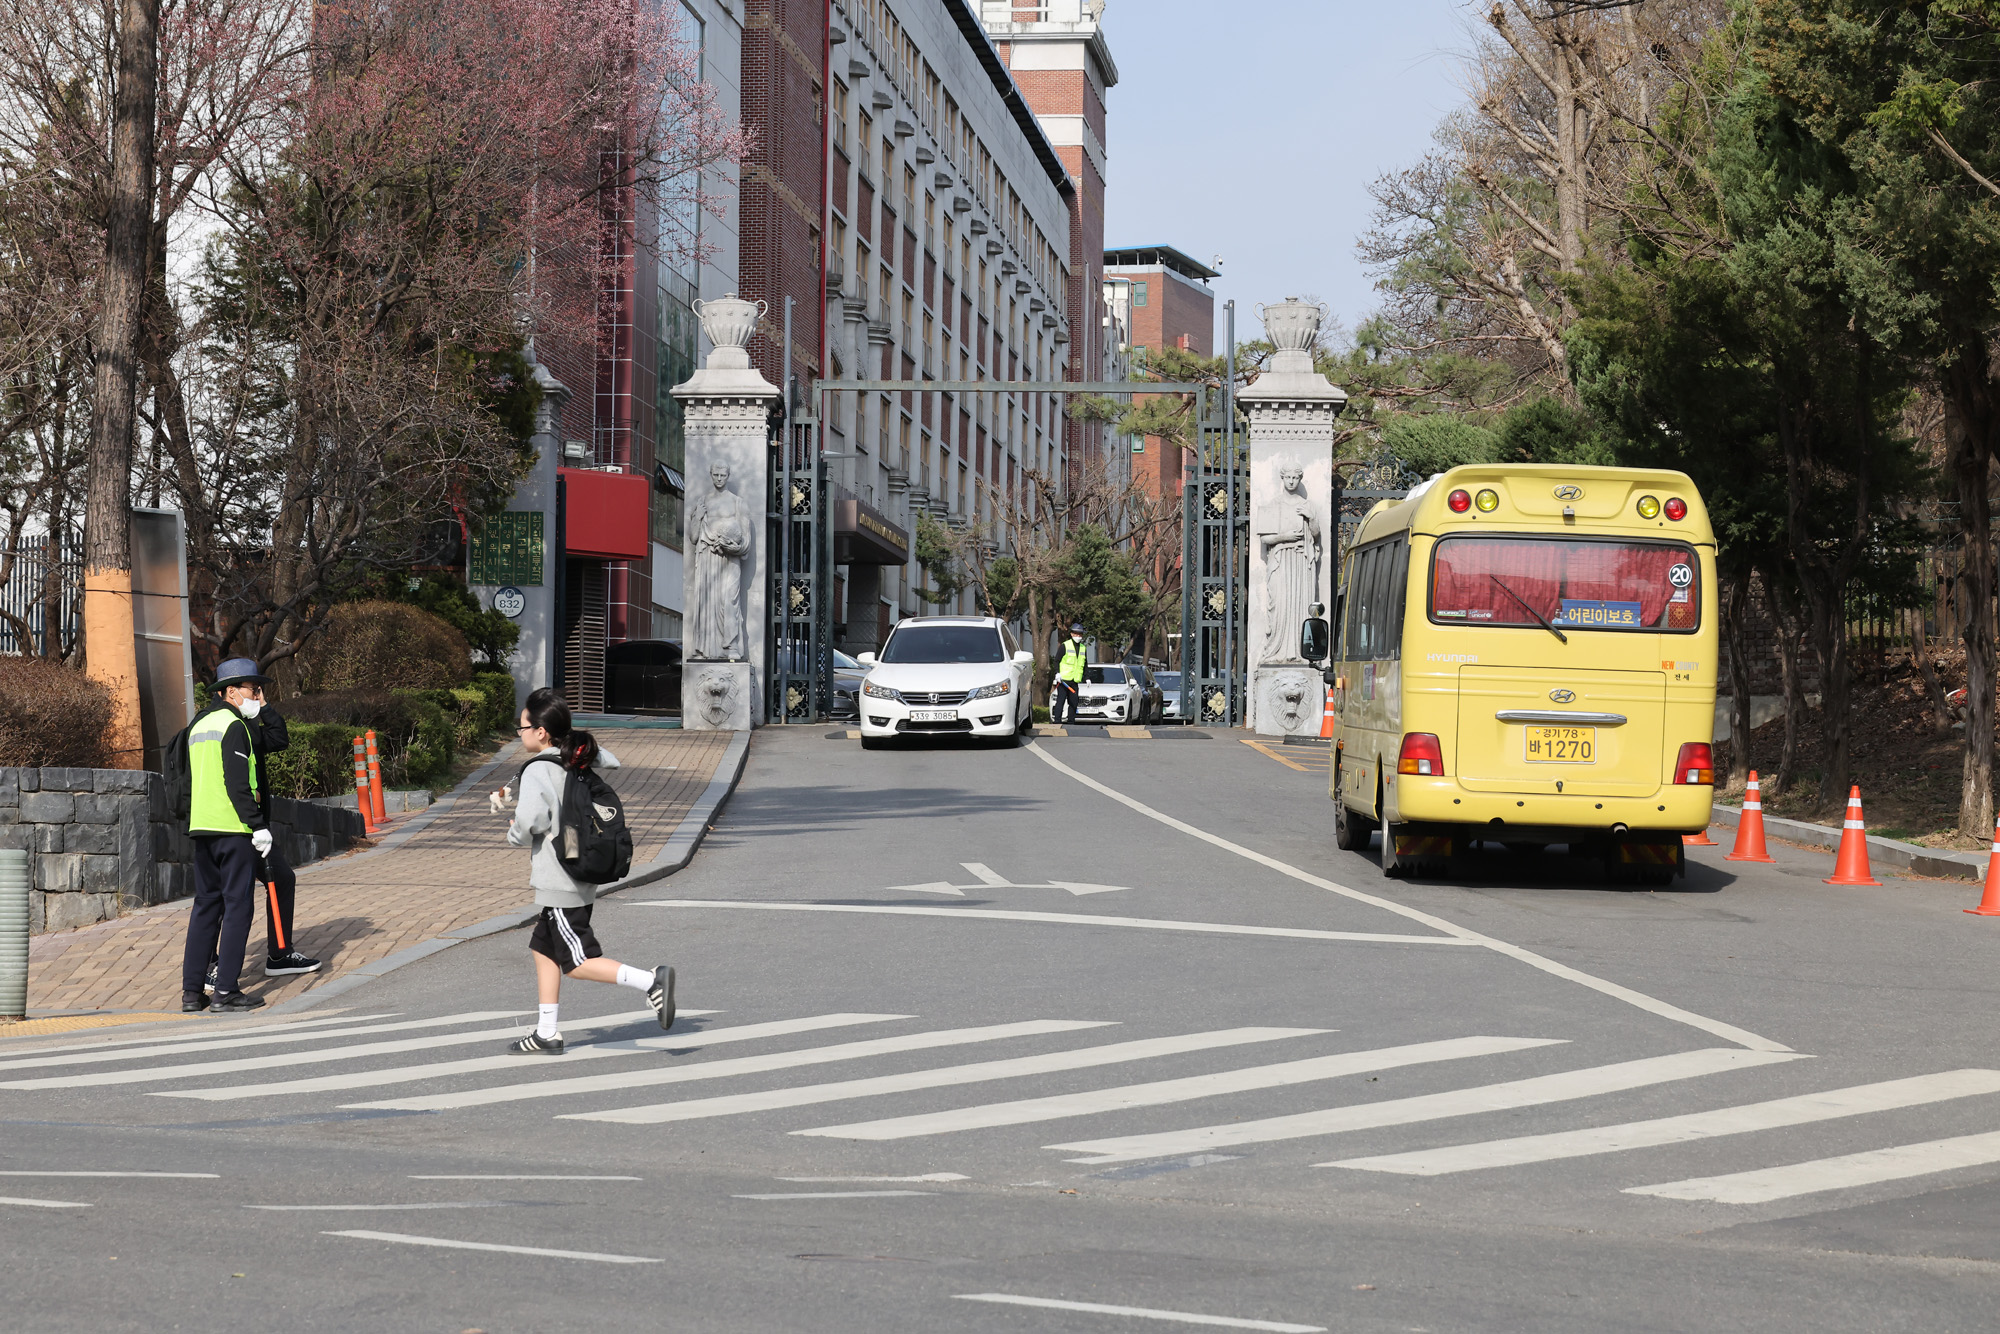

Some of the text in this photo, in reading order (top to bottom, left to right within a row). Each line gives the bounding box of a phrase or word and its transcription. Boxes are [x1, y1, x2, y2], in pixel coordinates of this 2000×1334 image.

[1671, 567, 1690, 583] 20
[499, 600, 520, 609] 832
[1569, 608, 1635, 624] 어린이보호
[1426, 653, 1479, 663] HYUNDAI
[1661, 660, 1699, 671] NEW COUNTY
[933, 712, 953, 720] 3085
[1543, 728, 1578, 739] 경기 78
[1529, 740, 1591, 759] 바 1270
